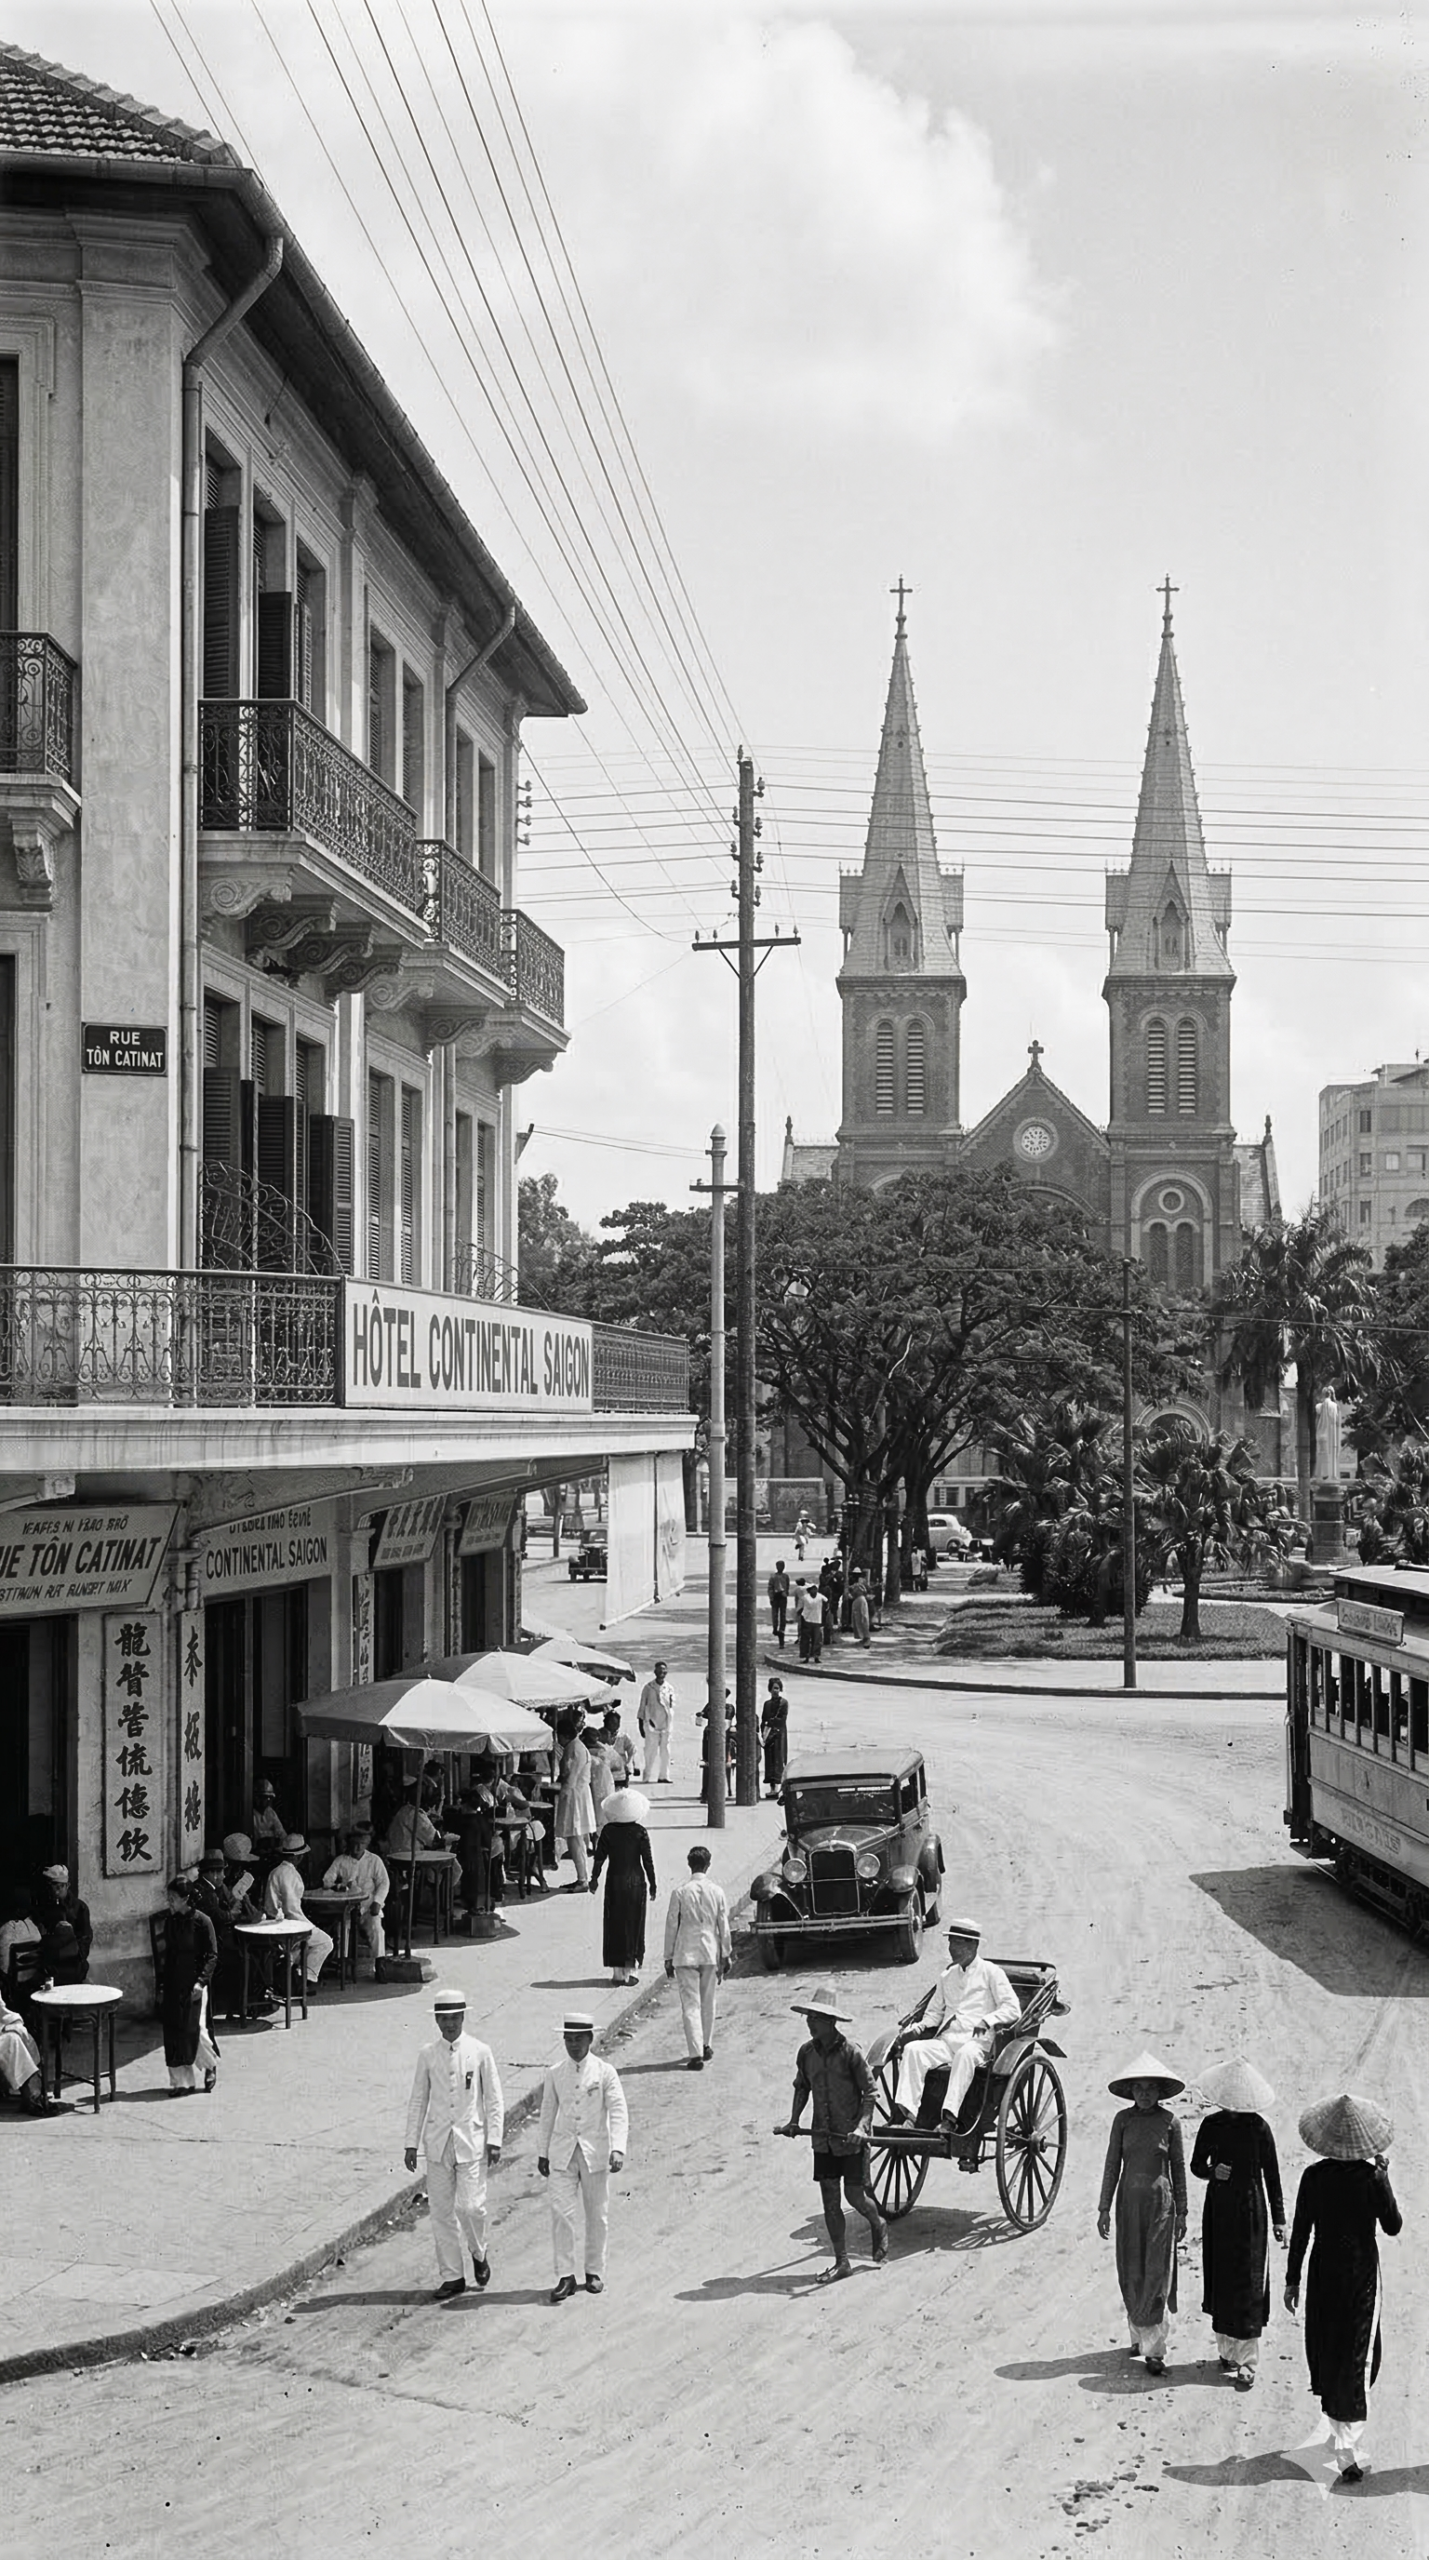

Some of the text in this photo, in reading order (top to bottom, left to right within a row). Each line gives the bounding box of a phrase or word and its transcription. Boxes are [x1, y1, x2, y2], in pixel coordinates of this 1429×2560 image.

[109, 1031, 141, 1045] RUE
[115, 1050, 163, 1068] CATINAT
[353, 1288, 589, 1398] HÔTEL CONTINENTAL SAIGON
[28, 1535, 74, 1577] TÔN
[75, 1536, 162, 1574] CATINAT
[206, 1536, 327, 1579] CONTINENTAL SAIGON
